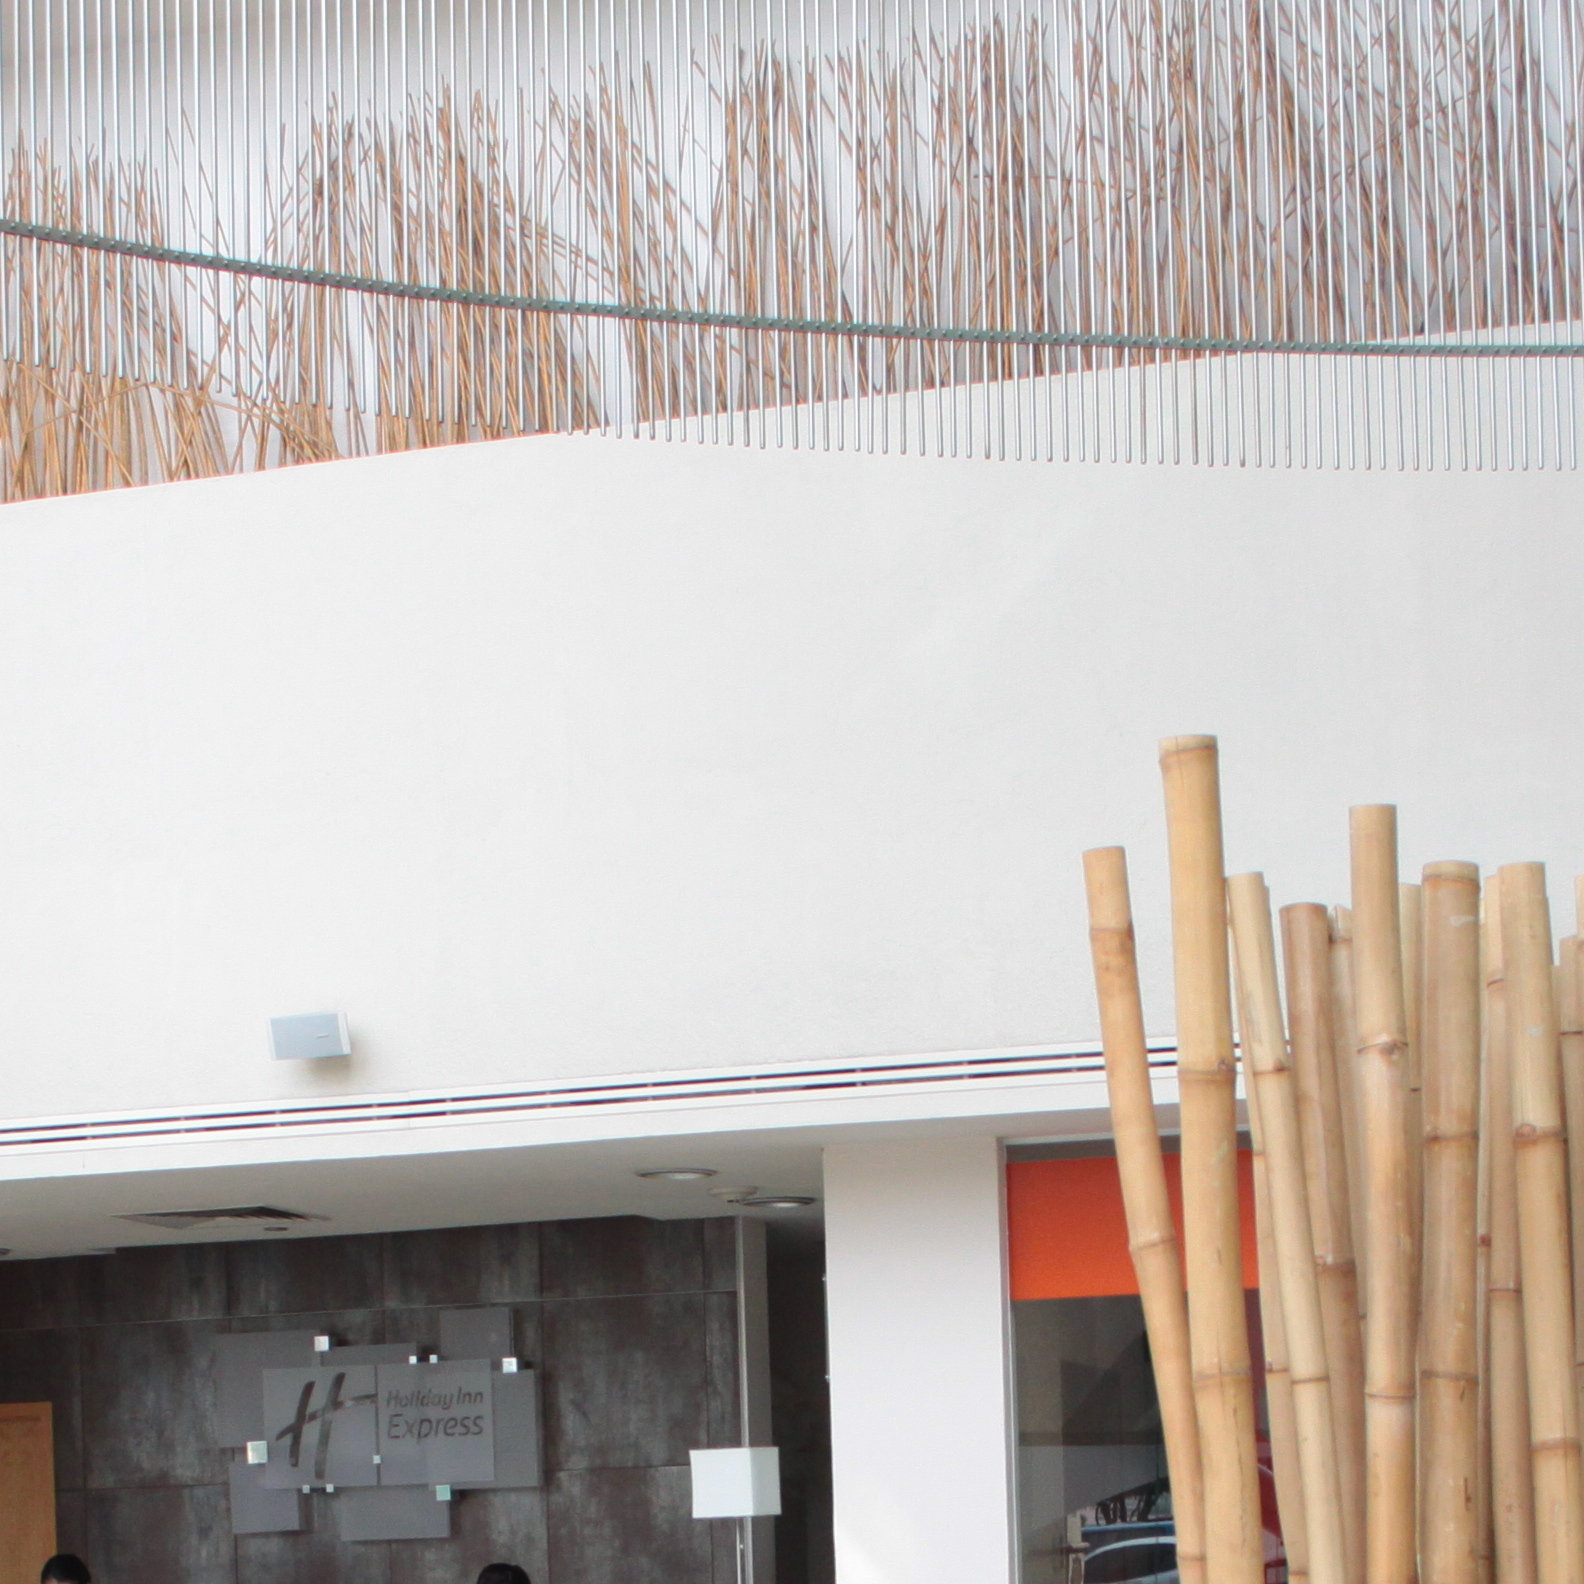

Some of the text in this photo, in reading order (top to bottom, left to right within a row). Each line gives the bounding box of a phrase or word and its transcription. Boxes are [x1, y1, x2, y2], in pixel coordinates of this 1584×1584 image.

[386, 1386, 484, 1411] Holiday Inn
[388, 1413, 484, 1442] Express
